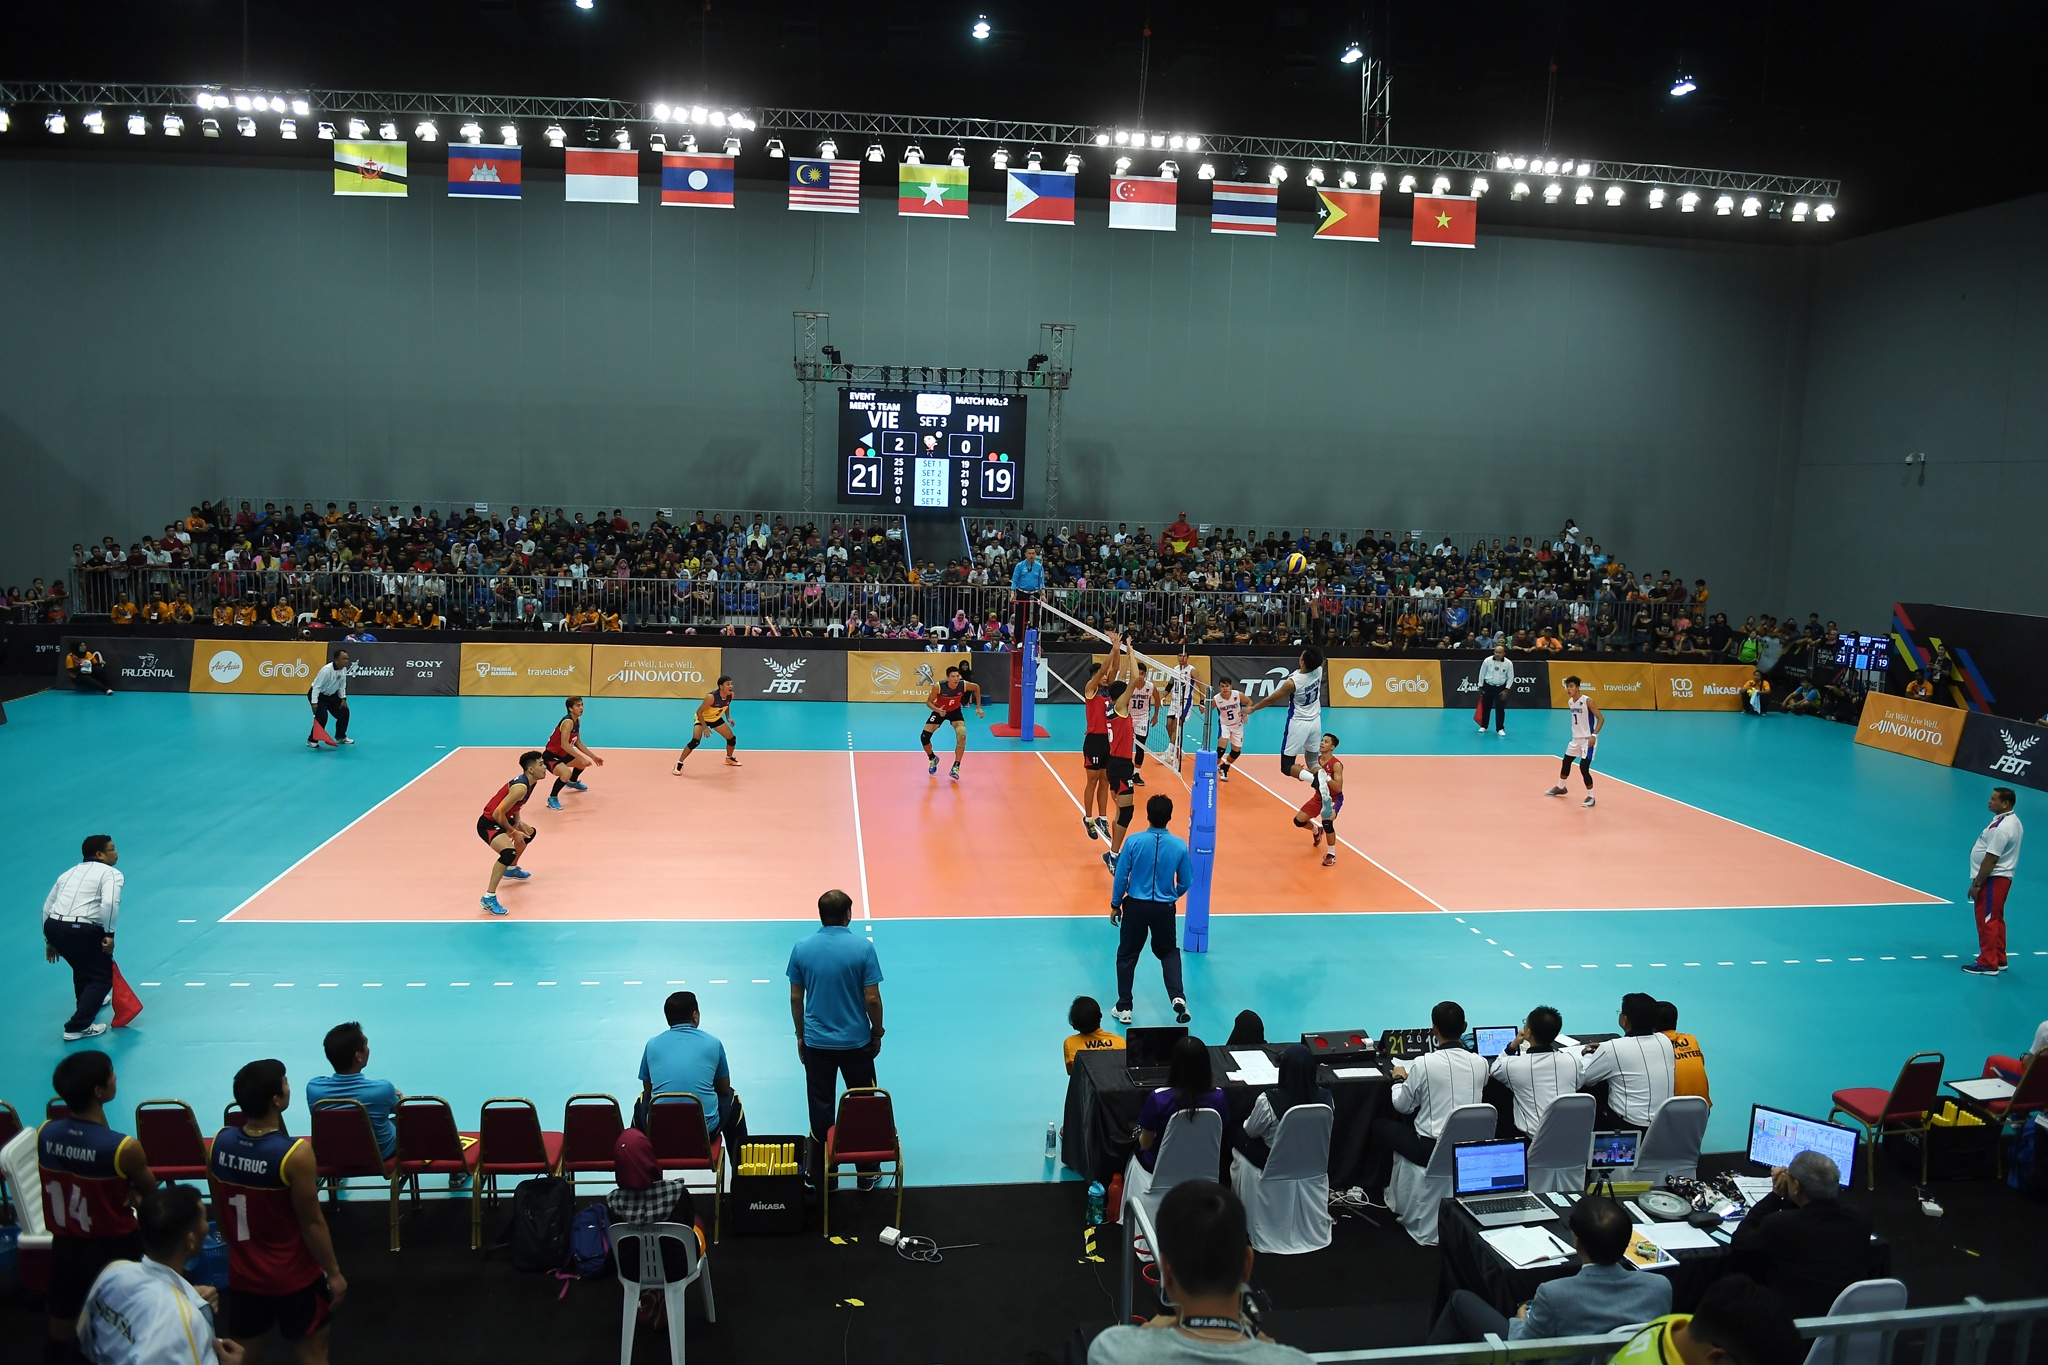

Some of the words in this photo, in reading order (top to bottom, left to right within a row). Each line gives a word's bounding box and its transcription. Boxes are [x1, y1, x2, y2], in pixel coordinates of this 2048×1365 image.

[850, 392, 876, 400] EVENT
[956, 396, 984, 405] MATCH
[850, 402, 876, 410] MEN'S
[877, 403, 900, 411] TEAM
[868, 411, 898, 428] VIE
[920, 416, 938, 427] SET
[940, 417, 947, 427] 3
[966, 414, 1000, 432] PHI
[894, 438, 904, 451] 2
[961, 440, 971, 454] 0
[961, 460, 970, 468] 19
[852, 464, 877, 488] 21
[984, 468, 1011, 492] 19
[121, 668, 175, 678] PRUDENTIAL
[258, 658, 310, 678] Grab
[607, 670, 702, 683] AJINOMOTO
[1386, 674, 1429, 692] Grab
[762, 679, 806, 694] FBT
[1604, 683, 1637, 692] traveloka
[1670, 678, 1692, 690] 100
[1132, 700, 1144, 709] 16
[1227, 710, 1234, 720] 5
[1573, 714, 1578, 724] 1
[1911, 716, 1922, 725] Live
[1869, 720, 1942, 745] AJINOMOTO
[1989, 754, 2031, 776] FBT
[1389, 1036, 1404, 1054] 21
[1407, 1035, 1413, 1043] 2
[1417, 1035, 1422, 1043] 0
[1674, 1050, 1701, 1060] UNTEE
[46, 1141, 96, 1162] V.H.QUAN
[219, 1151, 267, 1174] H.T.TRUC
[45, 1180, 92, 1233] 14
[228, 1194, 250, 1241] 1
